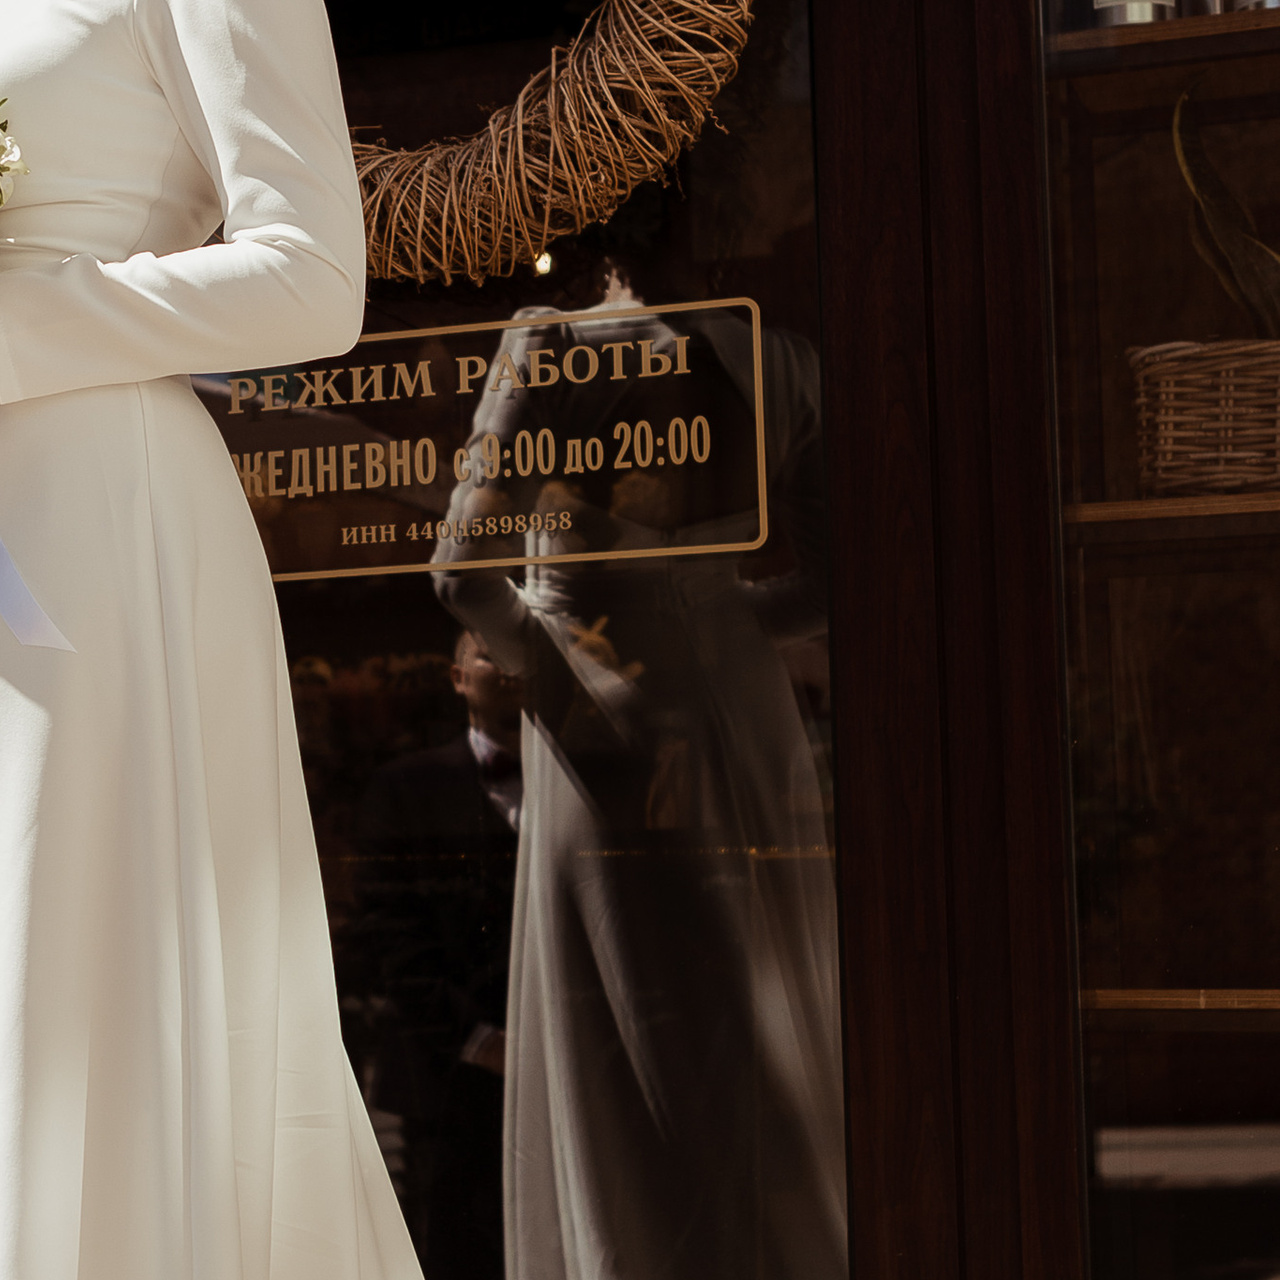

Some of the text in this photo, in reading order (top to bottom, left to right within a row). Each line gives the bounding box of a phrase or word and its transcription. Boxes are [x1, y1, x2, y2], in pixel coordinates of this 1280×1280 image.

[226, 334, 693, 416] РЕЖИМ РАБОТЫ
[232, 436, 438, 499] ЖЕДНЕВНО
[480, 427, 558, 480] 9:00
[564, 436, 605, 475] до
[612, 414, 712, 471] 20:00
[340, 511, 573, 546] ИНН 440115898958
